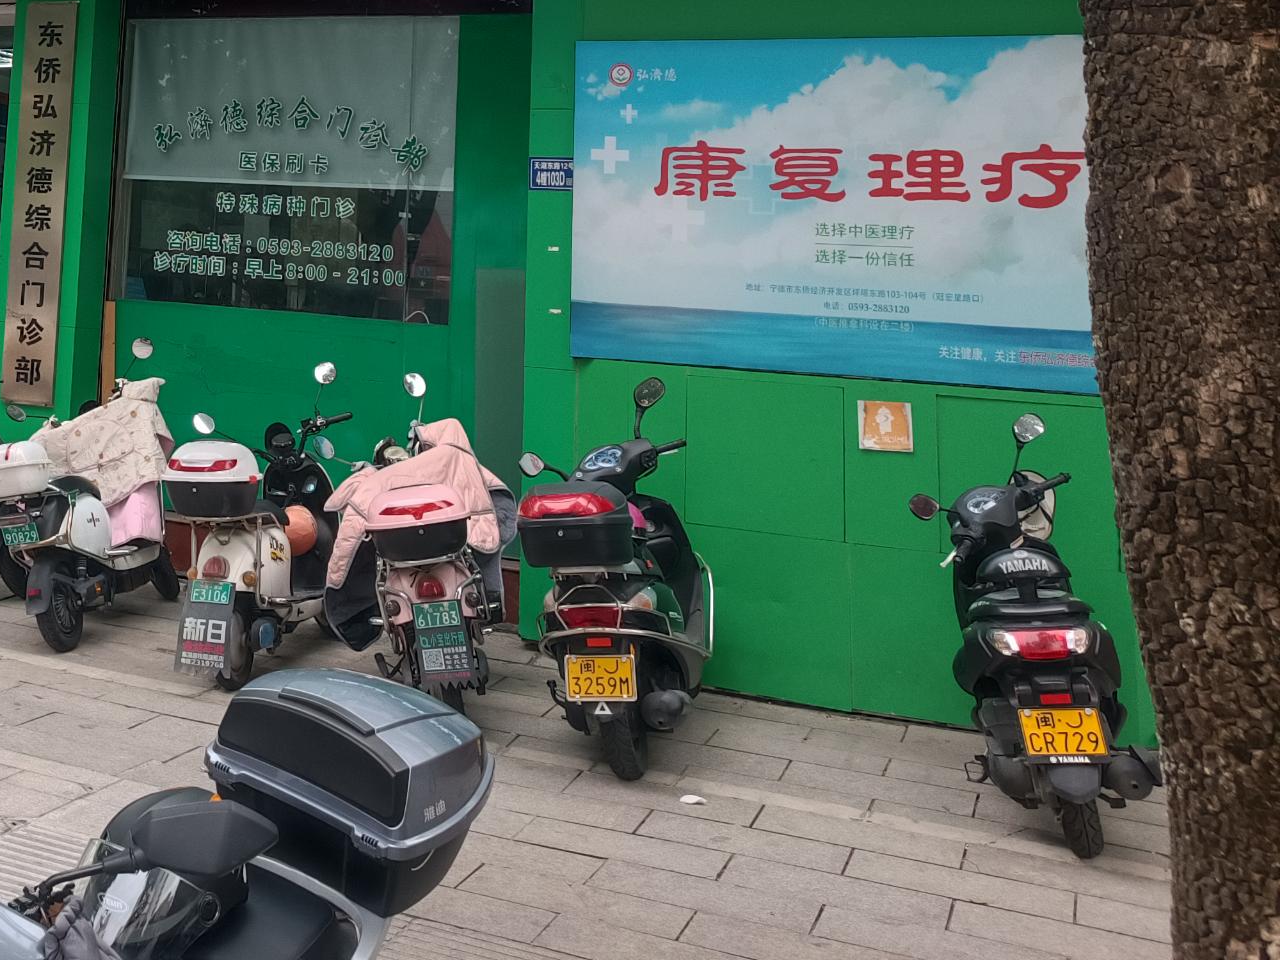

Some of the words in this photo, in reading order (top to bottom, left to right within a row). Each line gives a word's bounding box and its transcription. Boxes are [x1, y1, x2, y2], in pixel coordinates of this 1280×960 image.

[238, 151, 329, 174] 医保刷卡
[653, 139, 1087, 209] 康复理疗
[13, 20, 64, 387] 东侨弘济德综合门诊部
[216, 192, 356, 219] 特殊病种门诊
[814, 222, 916, 241] 选择中医理疗
[814, 248, 916, 268] 选择一份信任
[5, 530, 37, 544] 90829
[998, 558, 1050, 574] YAMAHA
[418, 610, 458, 627] 61783
[183, 617, 226, 644] 新日
[571, 677, 630, 696] 3259M
[1028, 731, 1100, 754] CR729
[1057, 756, 1091, 764] YAMAHA
